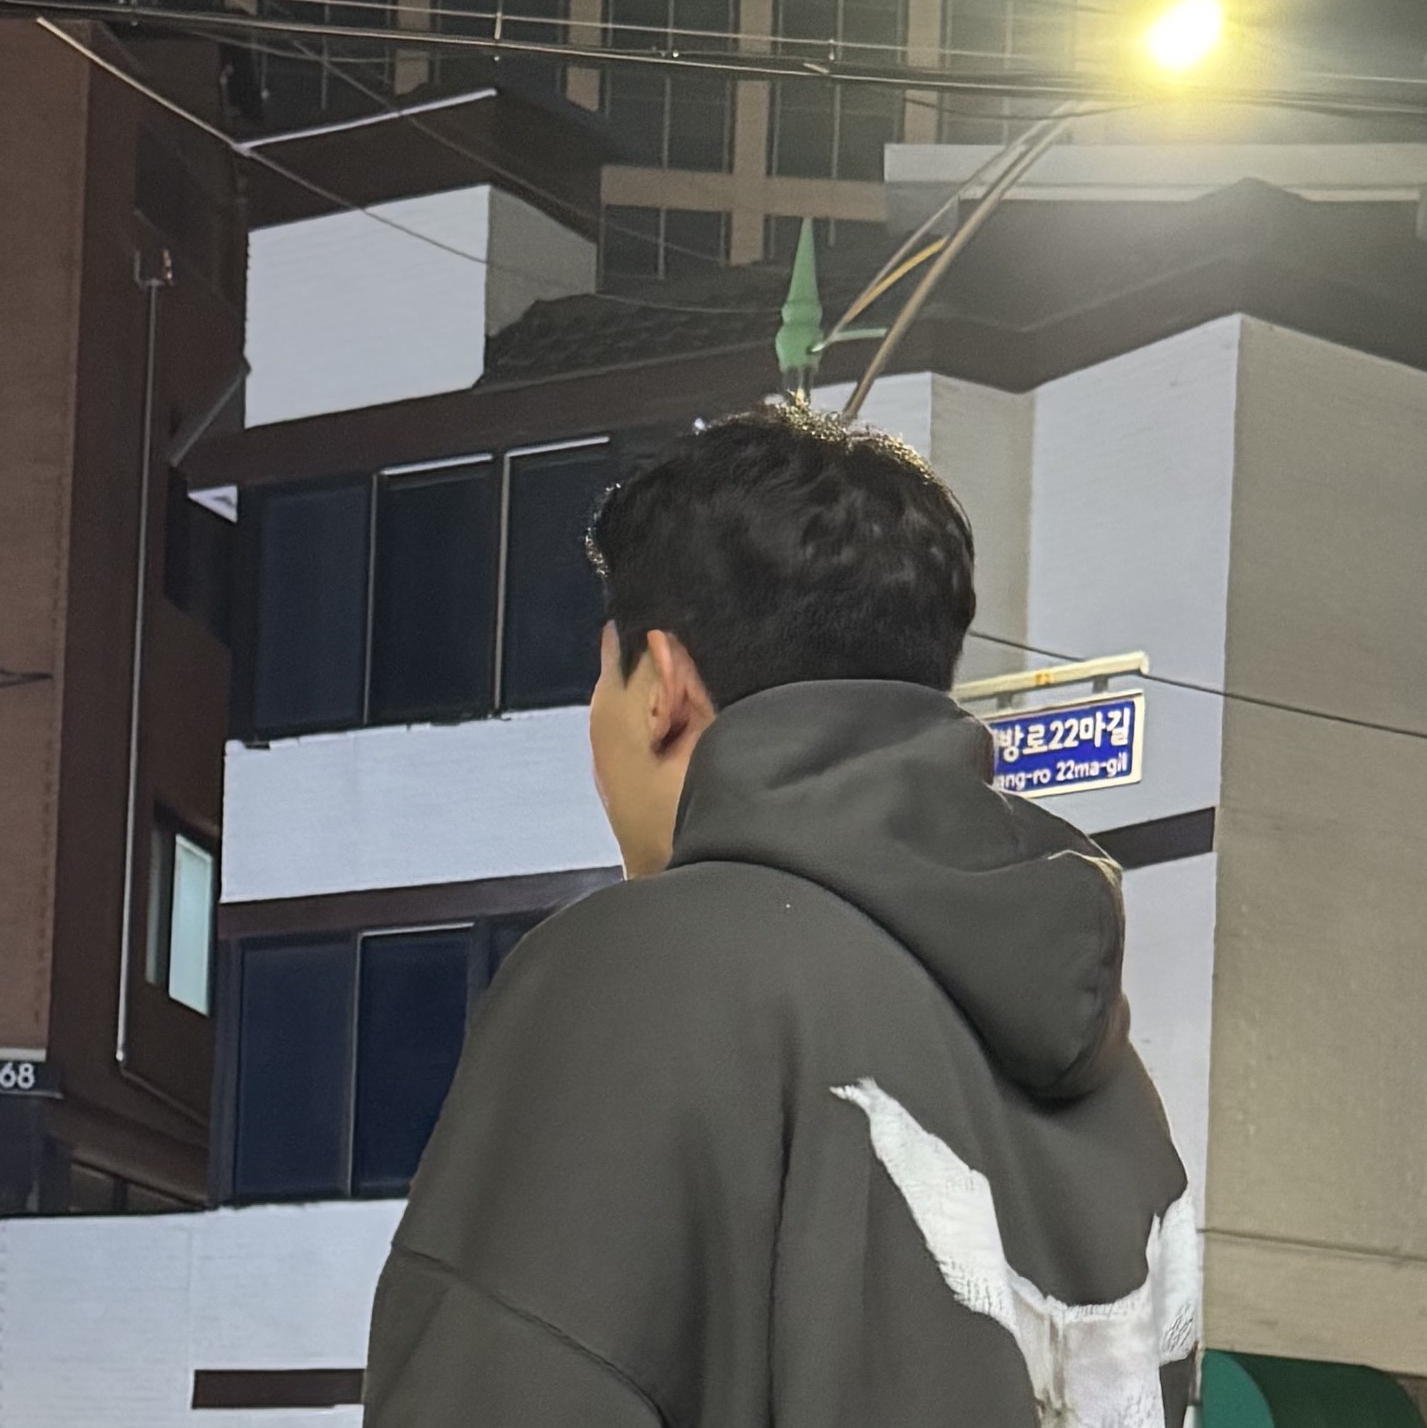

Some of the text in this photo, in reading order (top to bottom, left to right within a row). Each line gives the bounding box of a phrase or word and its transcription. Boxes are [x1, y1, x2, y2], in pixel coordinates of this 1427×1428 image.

[995, 707, 1130, 763] 방로22마길
[995, 751, 1128, 790] ang-ro 22ma-gil
